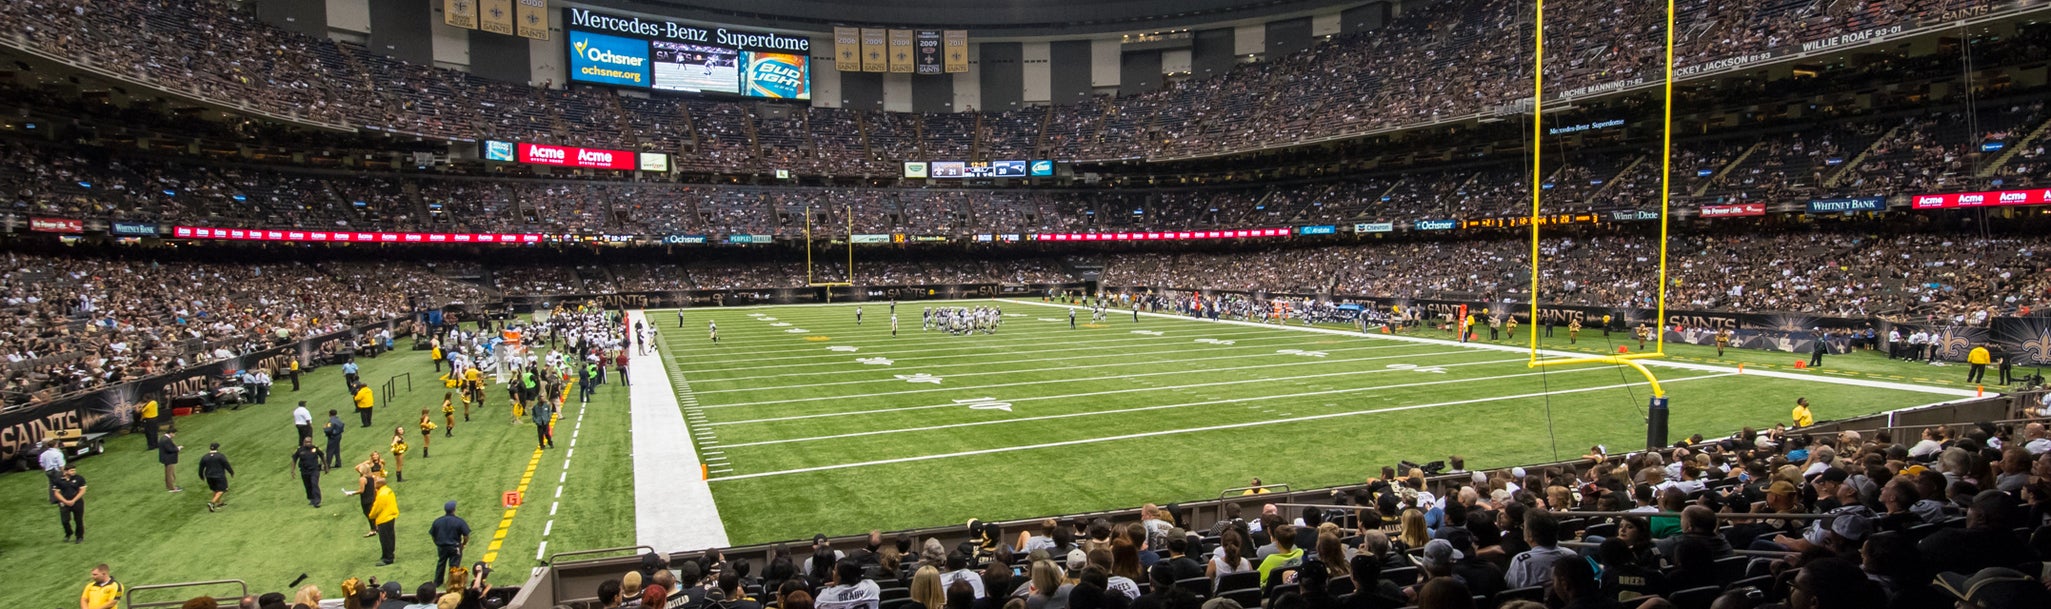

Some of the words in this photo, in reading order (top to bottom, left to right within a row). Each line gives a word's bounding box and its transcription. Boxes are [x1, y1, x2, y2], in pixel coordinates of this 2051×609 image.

[1942, 5, 1988, 21] SAINTS
[571, 8, 708, 42] Mercedes-Benz
[716, 28, 809, 51] Superdome
[1802, 36, 1838, 52] WILLIE
[1841, 29, 1872, 43] ROAF
[587, 47, 643, 66] Ochsner
[1702, 55, 1748, 72] JACKSON
[581, 65, 641, 83] ochsner.org
[758, 63, 801, 79] BUD
[753, 71, 802, 88] LIGHT
[1558, 88, 1587, 99] ARCHIE
[1587, 80, 1625, 96] MANNING
[1592, 119, 1625, 129] Superdome
[529, 144, 565, 159] Acme
[578, 148, 613, 163] Acme
[1919, 196, 1943, 204] Acme
[1958, 194, 1984, 203] Acme
[2000, 192, 2027, 201] Acme
[1813, 200, 1850, 210] WHITNEY
[1851, 200, 1875, 209] BANK
[1613, 211, 1632, 220] Winn
[1638, 210, 1658, 220] Dixie
[114, 223, 138, 233] WHITNEY
[140, 224, 154, 234] BANK
[1421, 220, 1453, 230] Ochsner
[670, 235, 704, 243] Ochsner
[1536, 308, 1584, 322] SAINTS
[1669, 315, 1736, 330] SAINTS
[0, 409, 79, 460] SAINTS
[506, 493, 517, 506] G
[1618, 575, 1646, 586] BREES
[838, 588, 865, 602] BRADY
